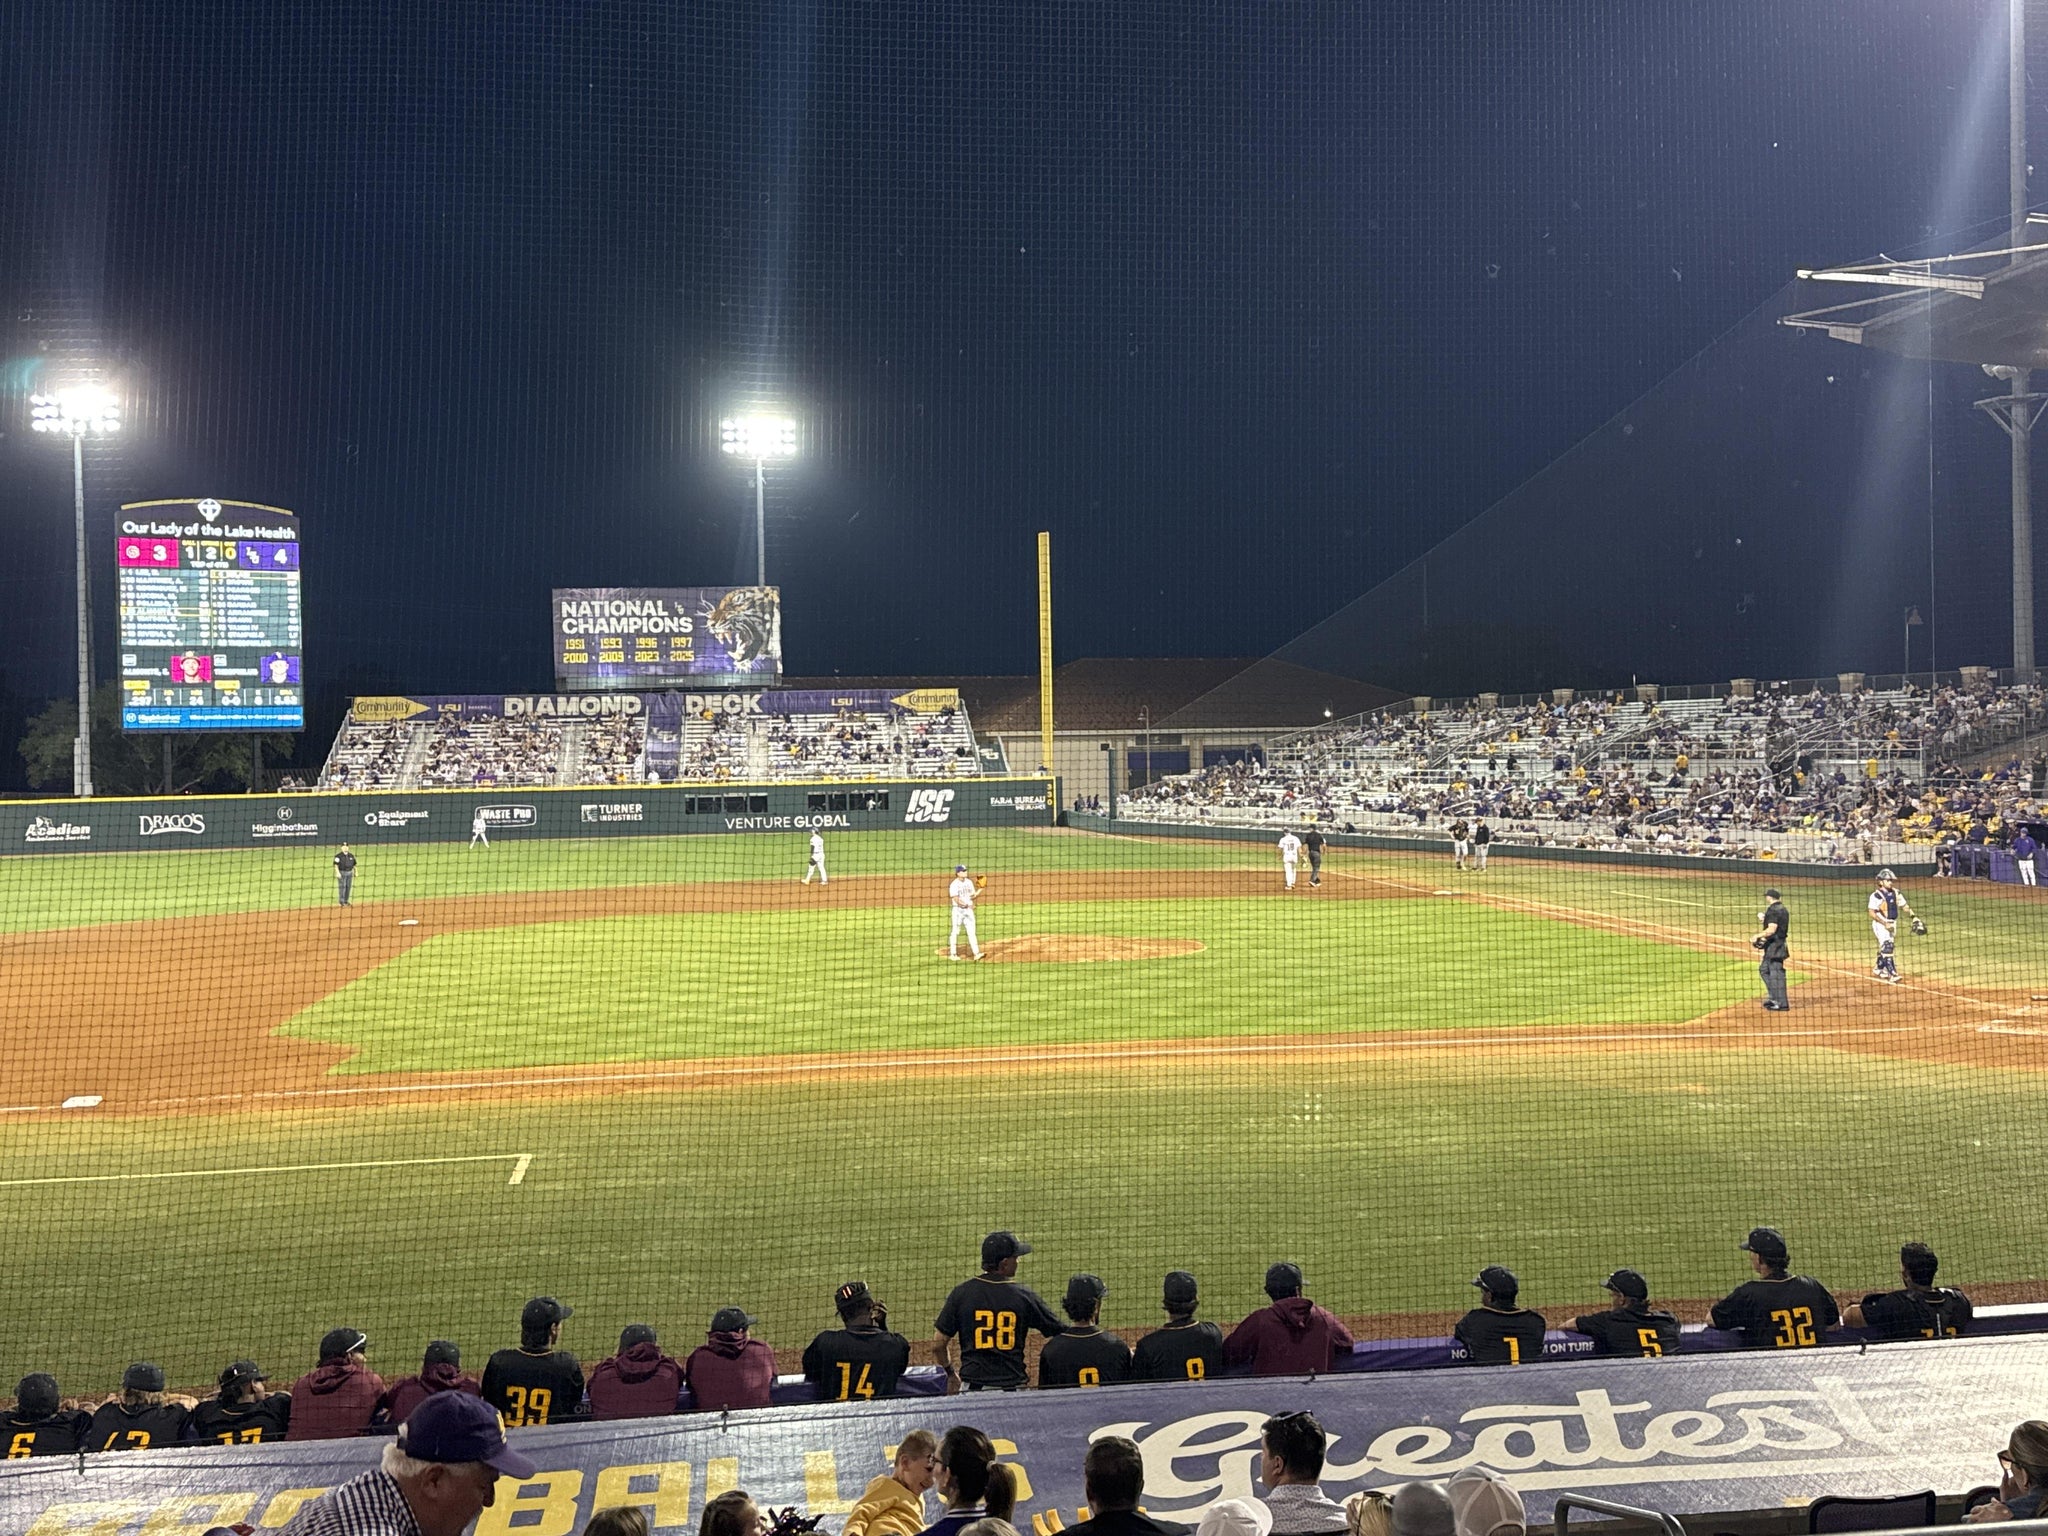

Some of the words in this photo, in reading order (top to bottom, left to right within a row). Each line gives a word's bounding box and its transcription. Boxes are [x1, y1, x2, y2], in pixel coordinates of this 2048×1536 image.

[122, 521, 149, 534] Our
[151, 522, 184, 537] Lady
[184, 523, 200, 536] of
[201, 524, 222, 536] the
[224, 525, 254, 538] Lake
[256, 527, 296, 540] Health
[153, 545, 167, 561] 3
[186, 546, 194, 559] 1
[206, 546, 217, 560] 2
[225, 547, 236, 560] 0
[274, 549, 288, 564] 4
[561, 600, 668, 617] NATIONAL
[562, 617, 693, 634] CHAMPIONS
[565, 638, 585, 650] 1991
[600, 638, 622, 648] 1993
[636, 638, 658, 648] 1996
[670, 636, 692, 648] 1997
[563, 652, 588, 664] 2000
[599, 652, 624, 663] 2009
[634, 651, 660, 662] 2023
[670, 650, 694, 662] 2025
[165, 696, 172, 706] 1
[356, 700, 410, 714] Community
[504, 696, 642, 717] DIAMOND
[686, 694, 763, 714] DECK
[832, 698, 853, 706] LSU
[909, 695, 957, 706] Community
[438, 704, 462, 712] LSU
[990, 796, 1012, 805] FARM
[1014, 795, 1046, 804] BUREAU
[378, 810, 428, 820] Equipment
[480, 809, 511, 820] WASTE
[514, 808, 532, 819] PRO
[599, 804, 643, 814] TURNER
[139, 812, 206, 836] DRAGO'S
[600, 814, 643, 822] INDUSTRIES
[724, 816, 791, 830] VENTURE
[793, 814, 850, 828] GLOBAL
[25, 823, 91, 836] Acadian
[252, 822, 318, 833] Higginbotham
[974, 1310, 1017, 1350] 28
[1770, 1306, 1817, 1347] 32
[1550, 1342, 1566, 1354] ON
[1568, 1341, 1595, 1352] TURF
[1636, 1328, 1662, 1358] 5
[1451, 1349, 1468, 1360] NO
[1504, 1337, 1520, 1366] 1
[836, 1362, 875, 1400] 14
[504, 1386, 552, 1427] 39
[8, 1432, 37, 1460] 6
